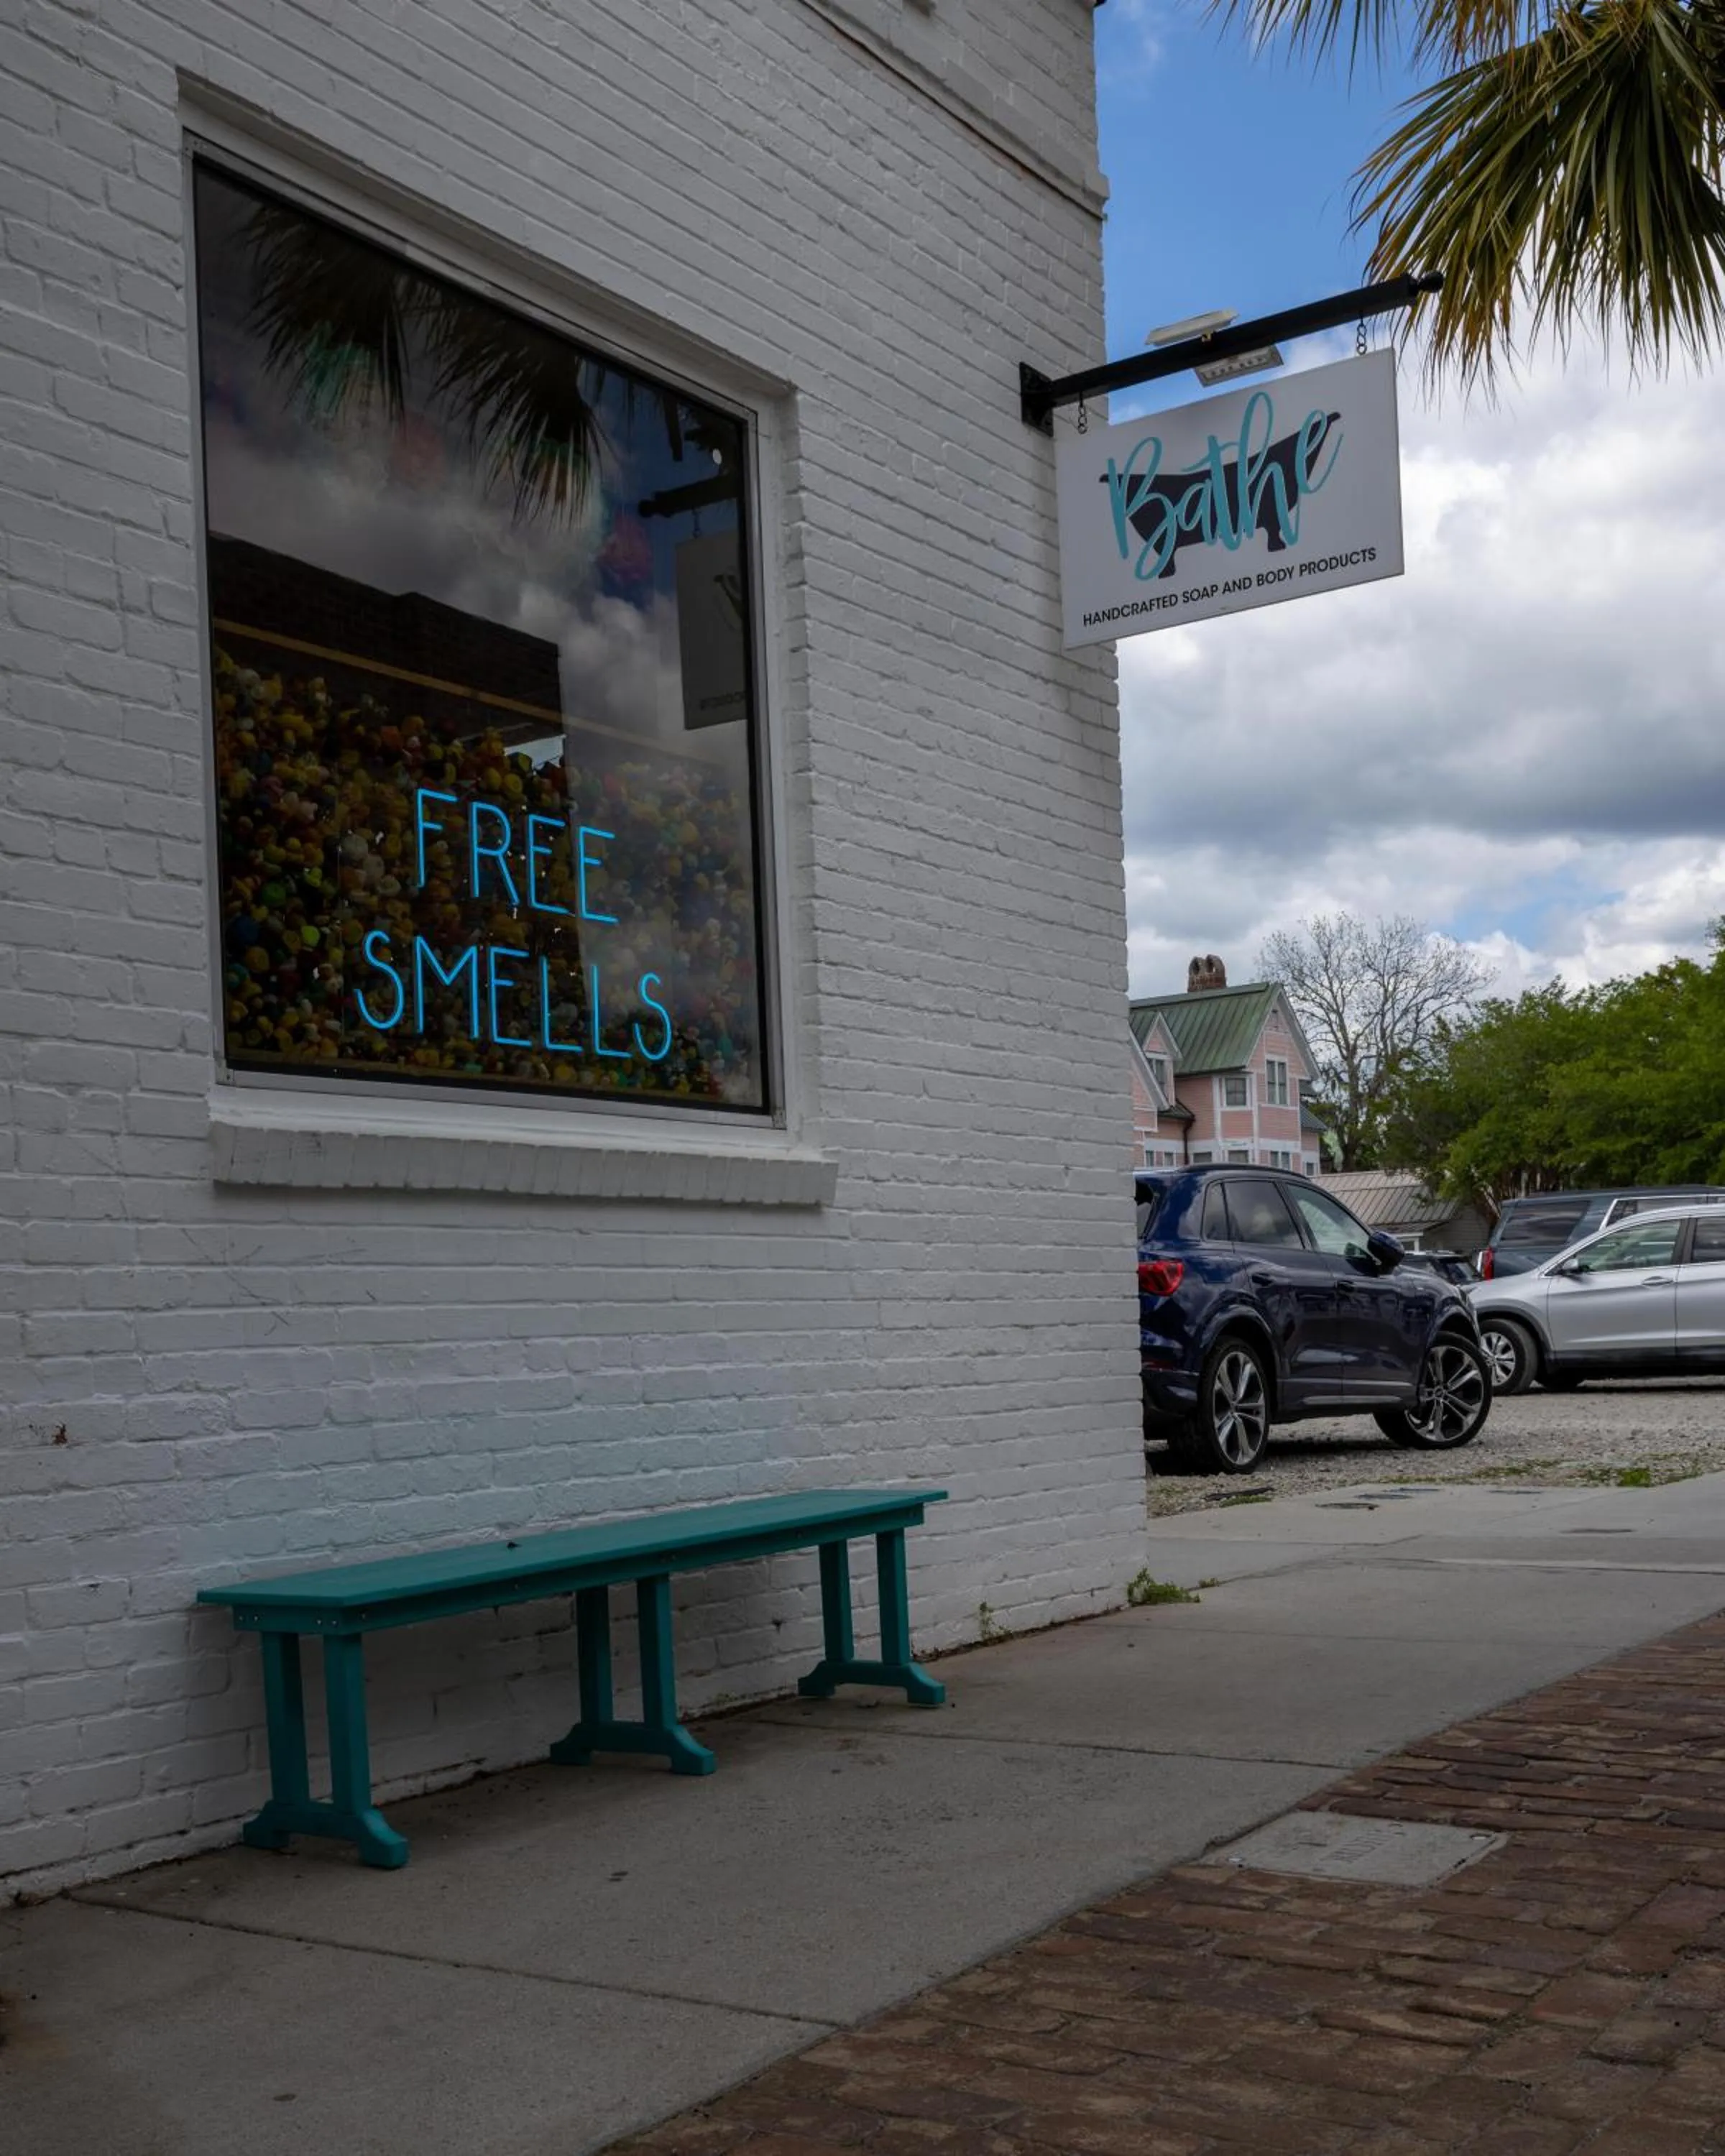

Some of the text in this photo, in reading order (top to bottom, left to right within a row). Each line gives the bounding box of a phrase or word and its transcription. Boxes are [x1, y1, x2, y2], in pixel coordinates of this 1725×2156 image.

[1107, 391, 1343, 581] Bathe
[1083, 546, 1376, 627] HANDCRAFTED SOAP AND BODY PRODUCTS
[417, 788, 619, 924] FREE
[354, 929, 672, 1061] SMELLS
